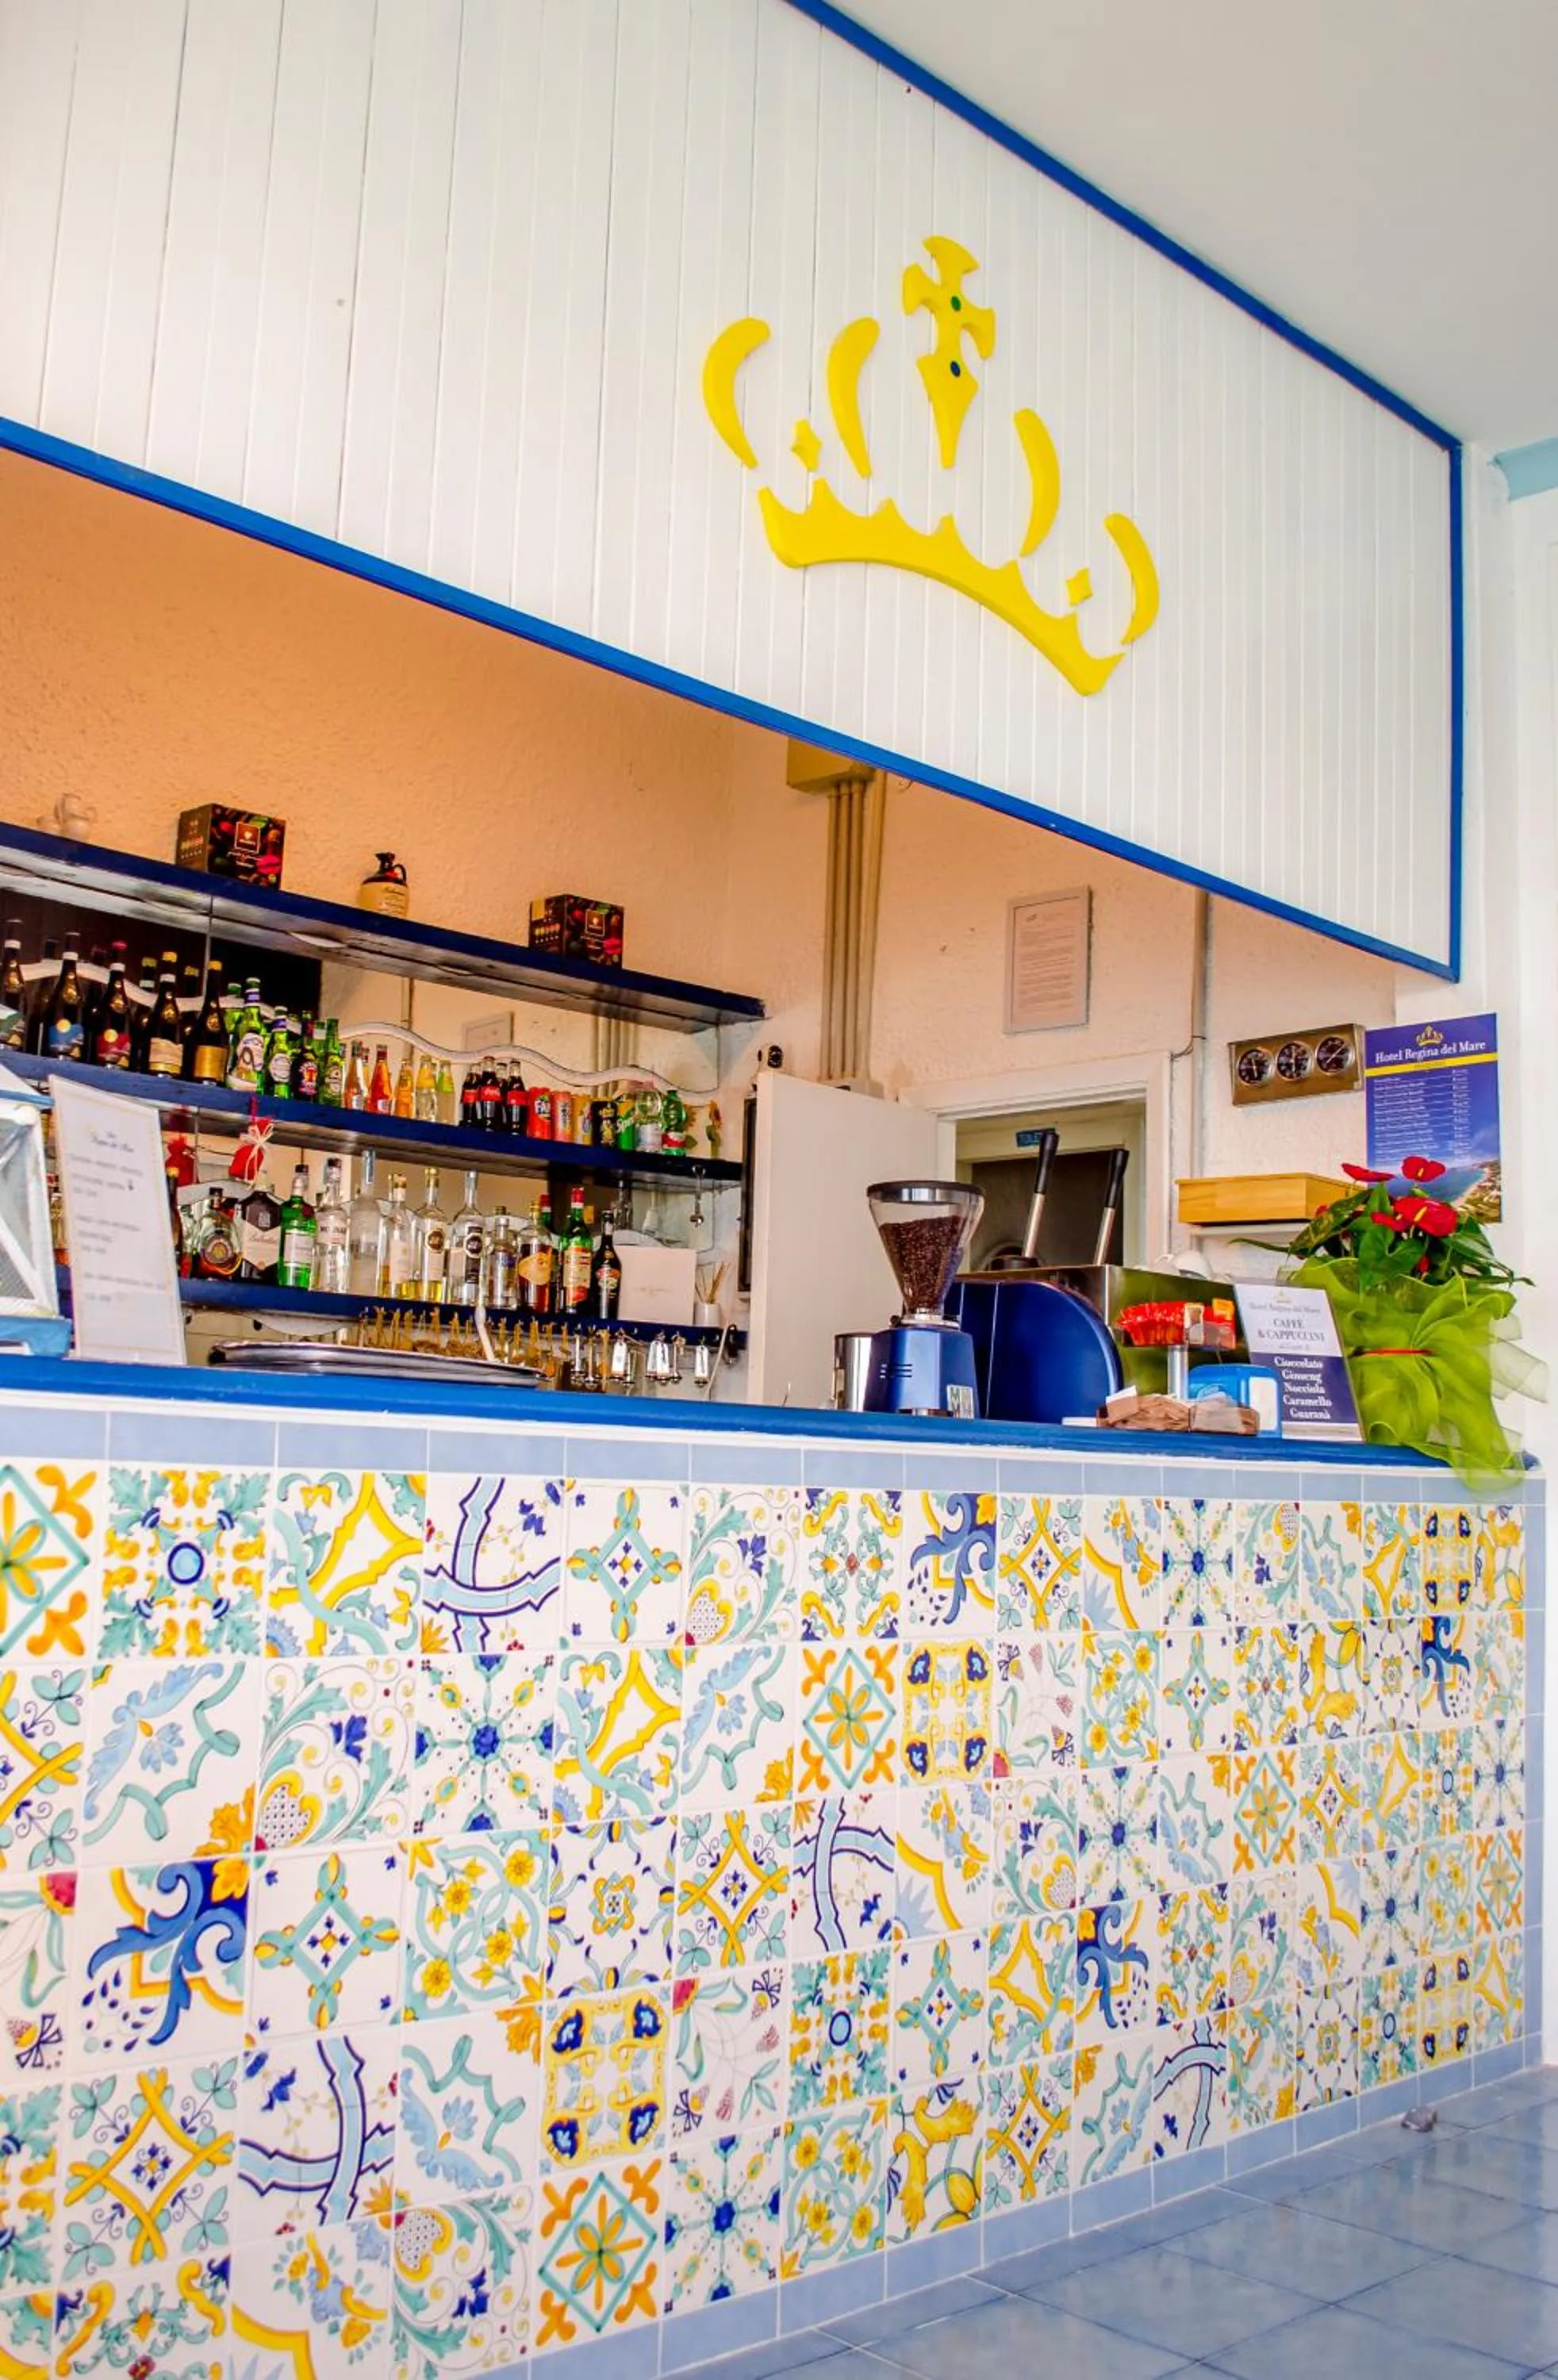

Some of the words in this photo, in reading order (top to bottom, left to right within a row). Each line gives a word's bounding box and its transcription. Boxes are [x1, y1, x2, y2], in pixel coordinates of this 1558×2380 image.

[1375, 1050, 1403, 1063] Hotel
[1405, 1047, 1439, 1061] Regina
[1441, 1042, 1457, 1054] del
[1460, 1041, 1486, 1053] Mare
[1257, 1330, 1264, 1338] &
[1267, 1330, 1325, 1342] CAPPUCCINI
[1274, 1357, 1323, 1368] Cioccolato
[1281, 1369, 1322, 1384] Ginseng
[1284, 1382, 1326, 1394] Nocciola
[1283, 1395, 1332, 1407] Caramello
